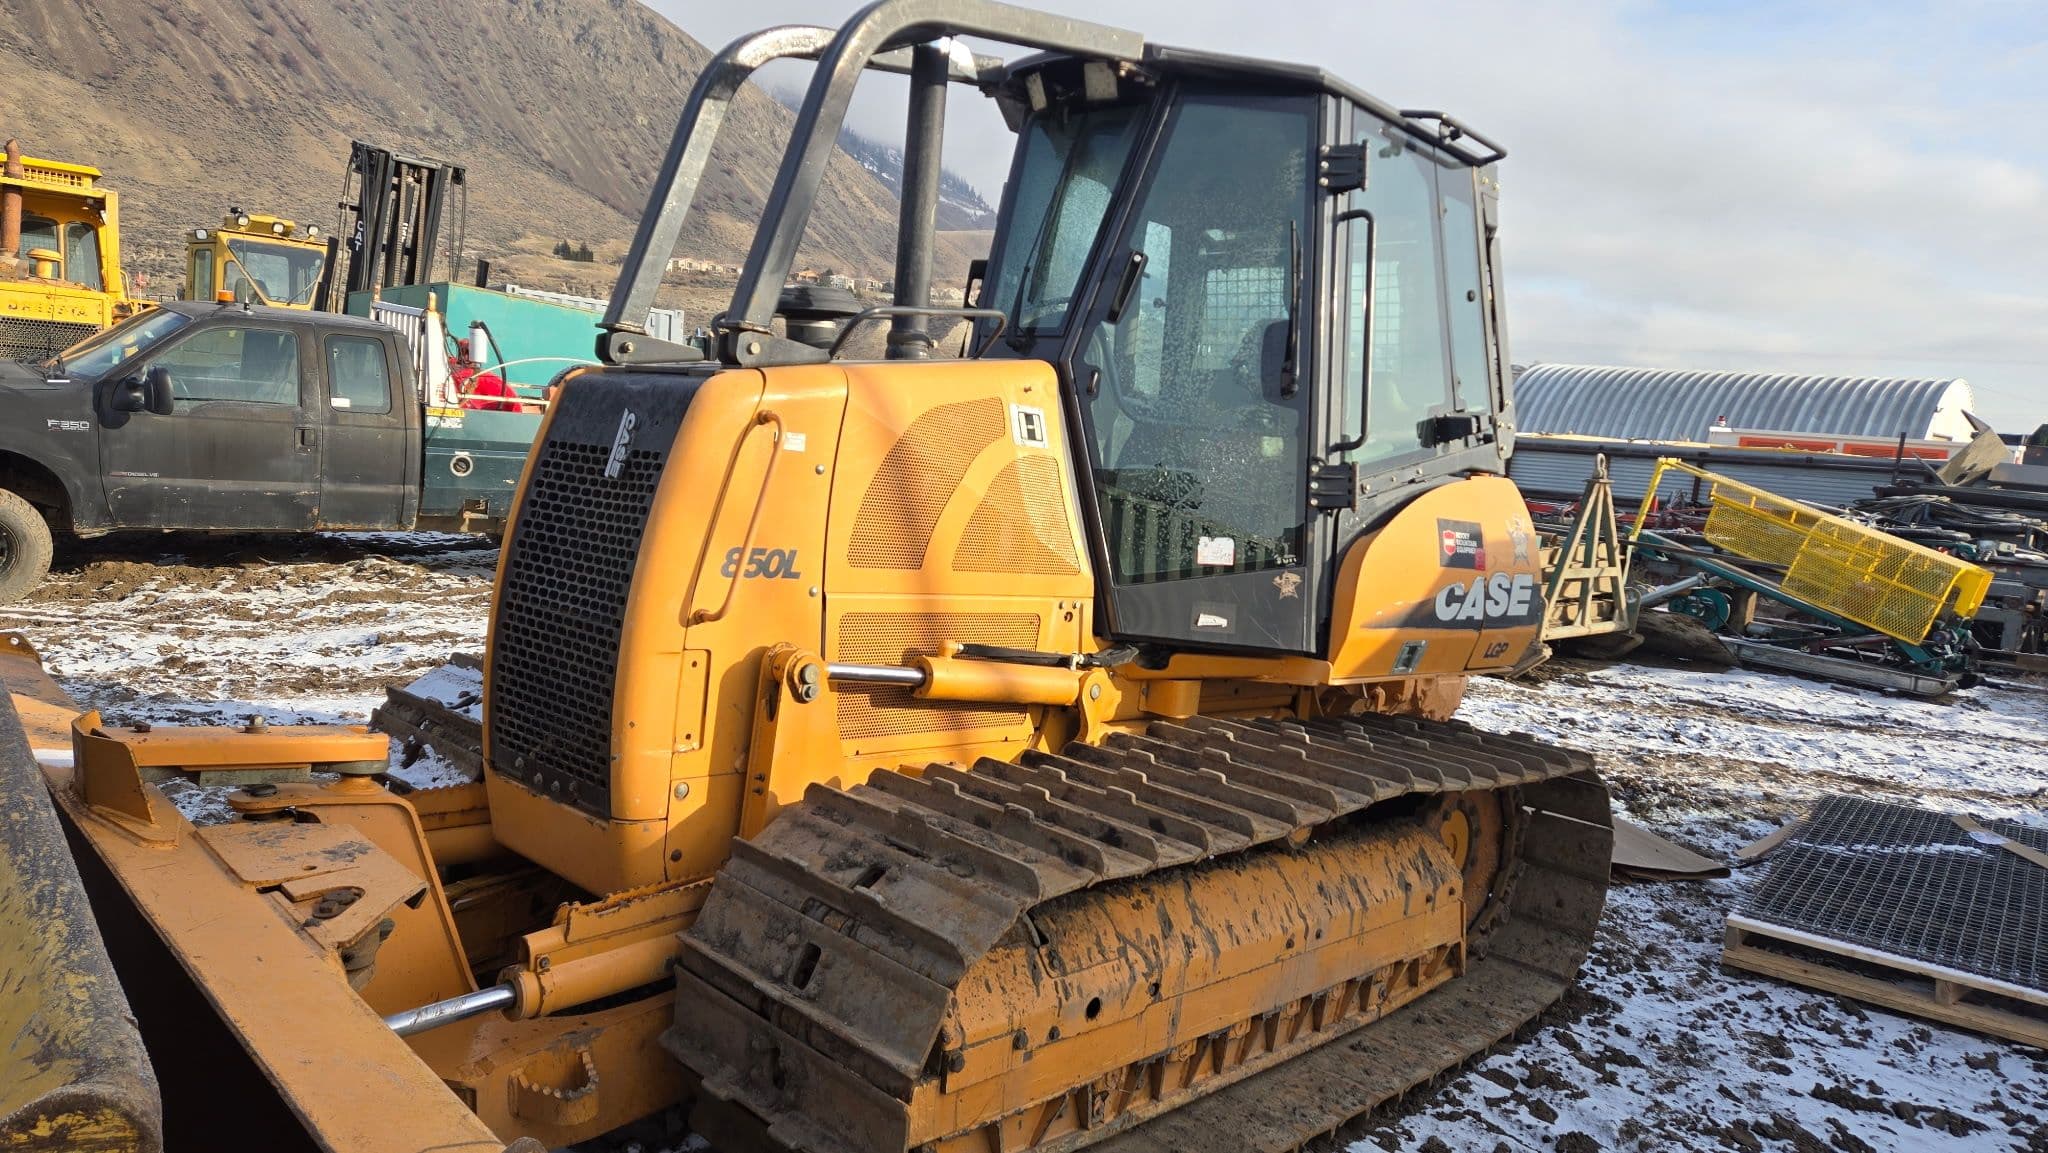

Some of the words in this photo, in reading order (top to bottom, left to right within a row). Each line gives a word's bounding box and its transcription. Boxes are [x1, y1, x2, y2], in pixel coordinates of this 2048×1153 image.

[354, 220, 364, 251] CAT
[607, 411, 636, 479] CASE
[720, 547, 801, 579] 850L
[1435, 572, 1533, 621] CASE
